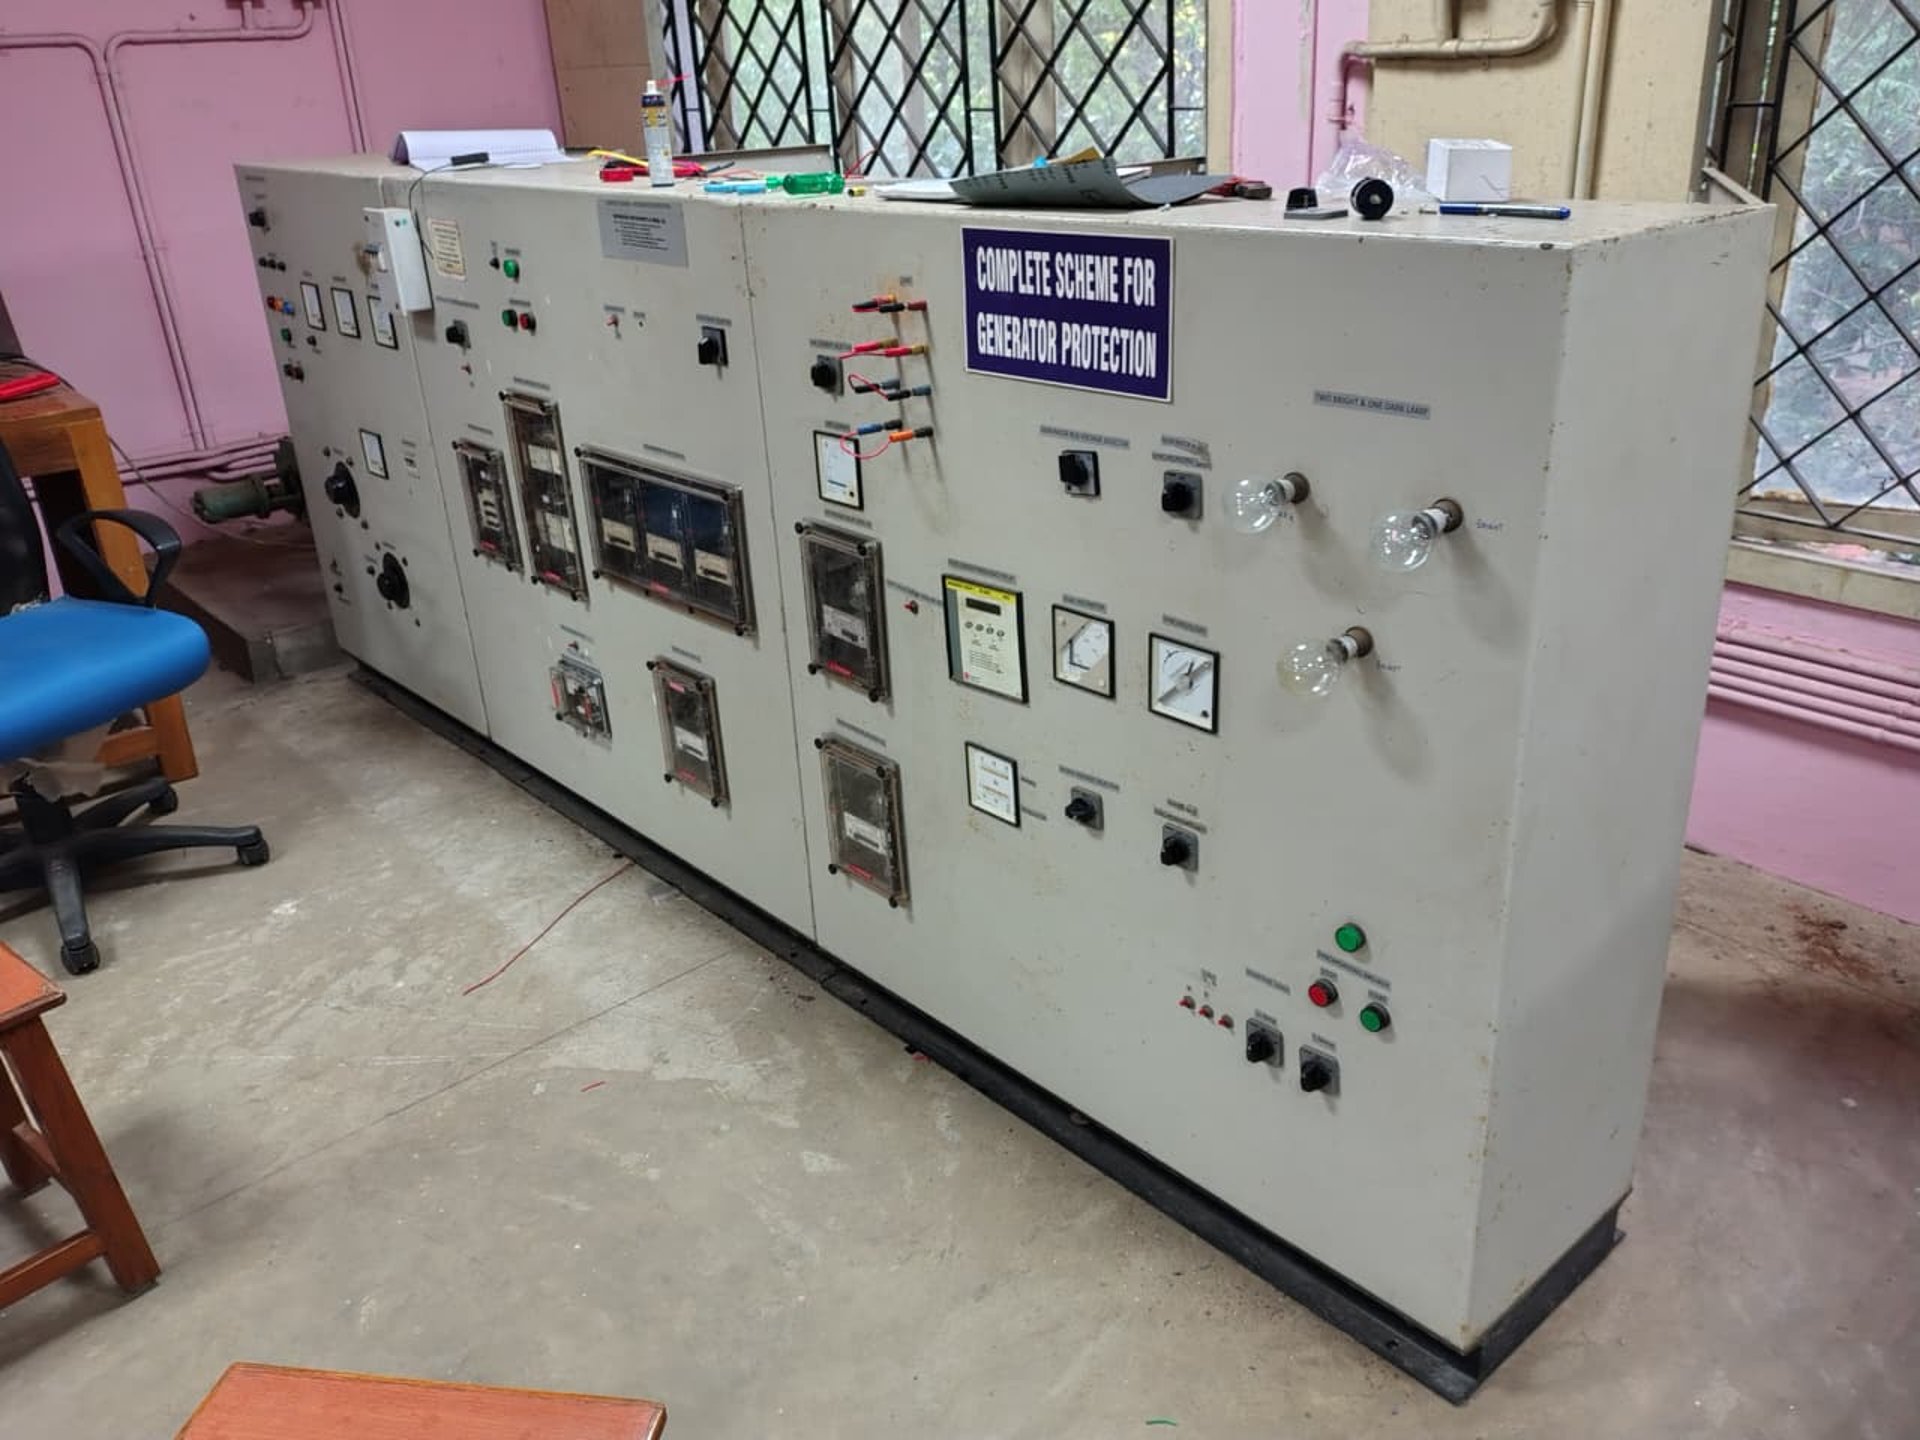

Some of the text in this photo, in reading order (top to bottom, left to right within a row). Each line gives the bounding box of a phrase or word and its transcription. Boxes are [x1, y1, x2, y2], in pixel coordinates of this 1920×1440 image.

[976, 245, 1156, 307] COMPLETE SCHEME FOR
[976, 311, 1156, 379] GENERATOR PROTECTION
